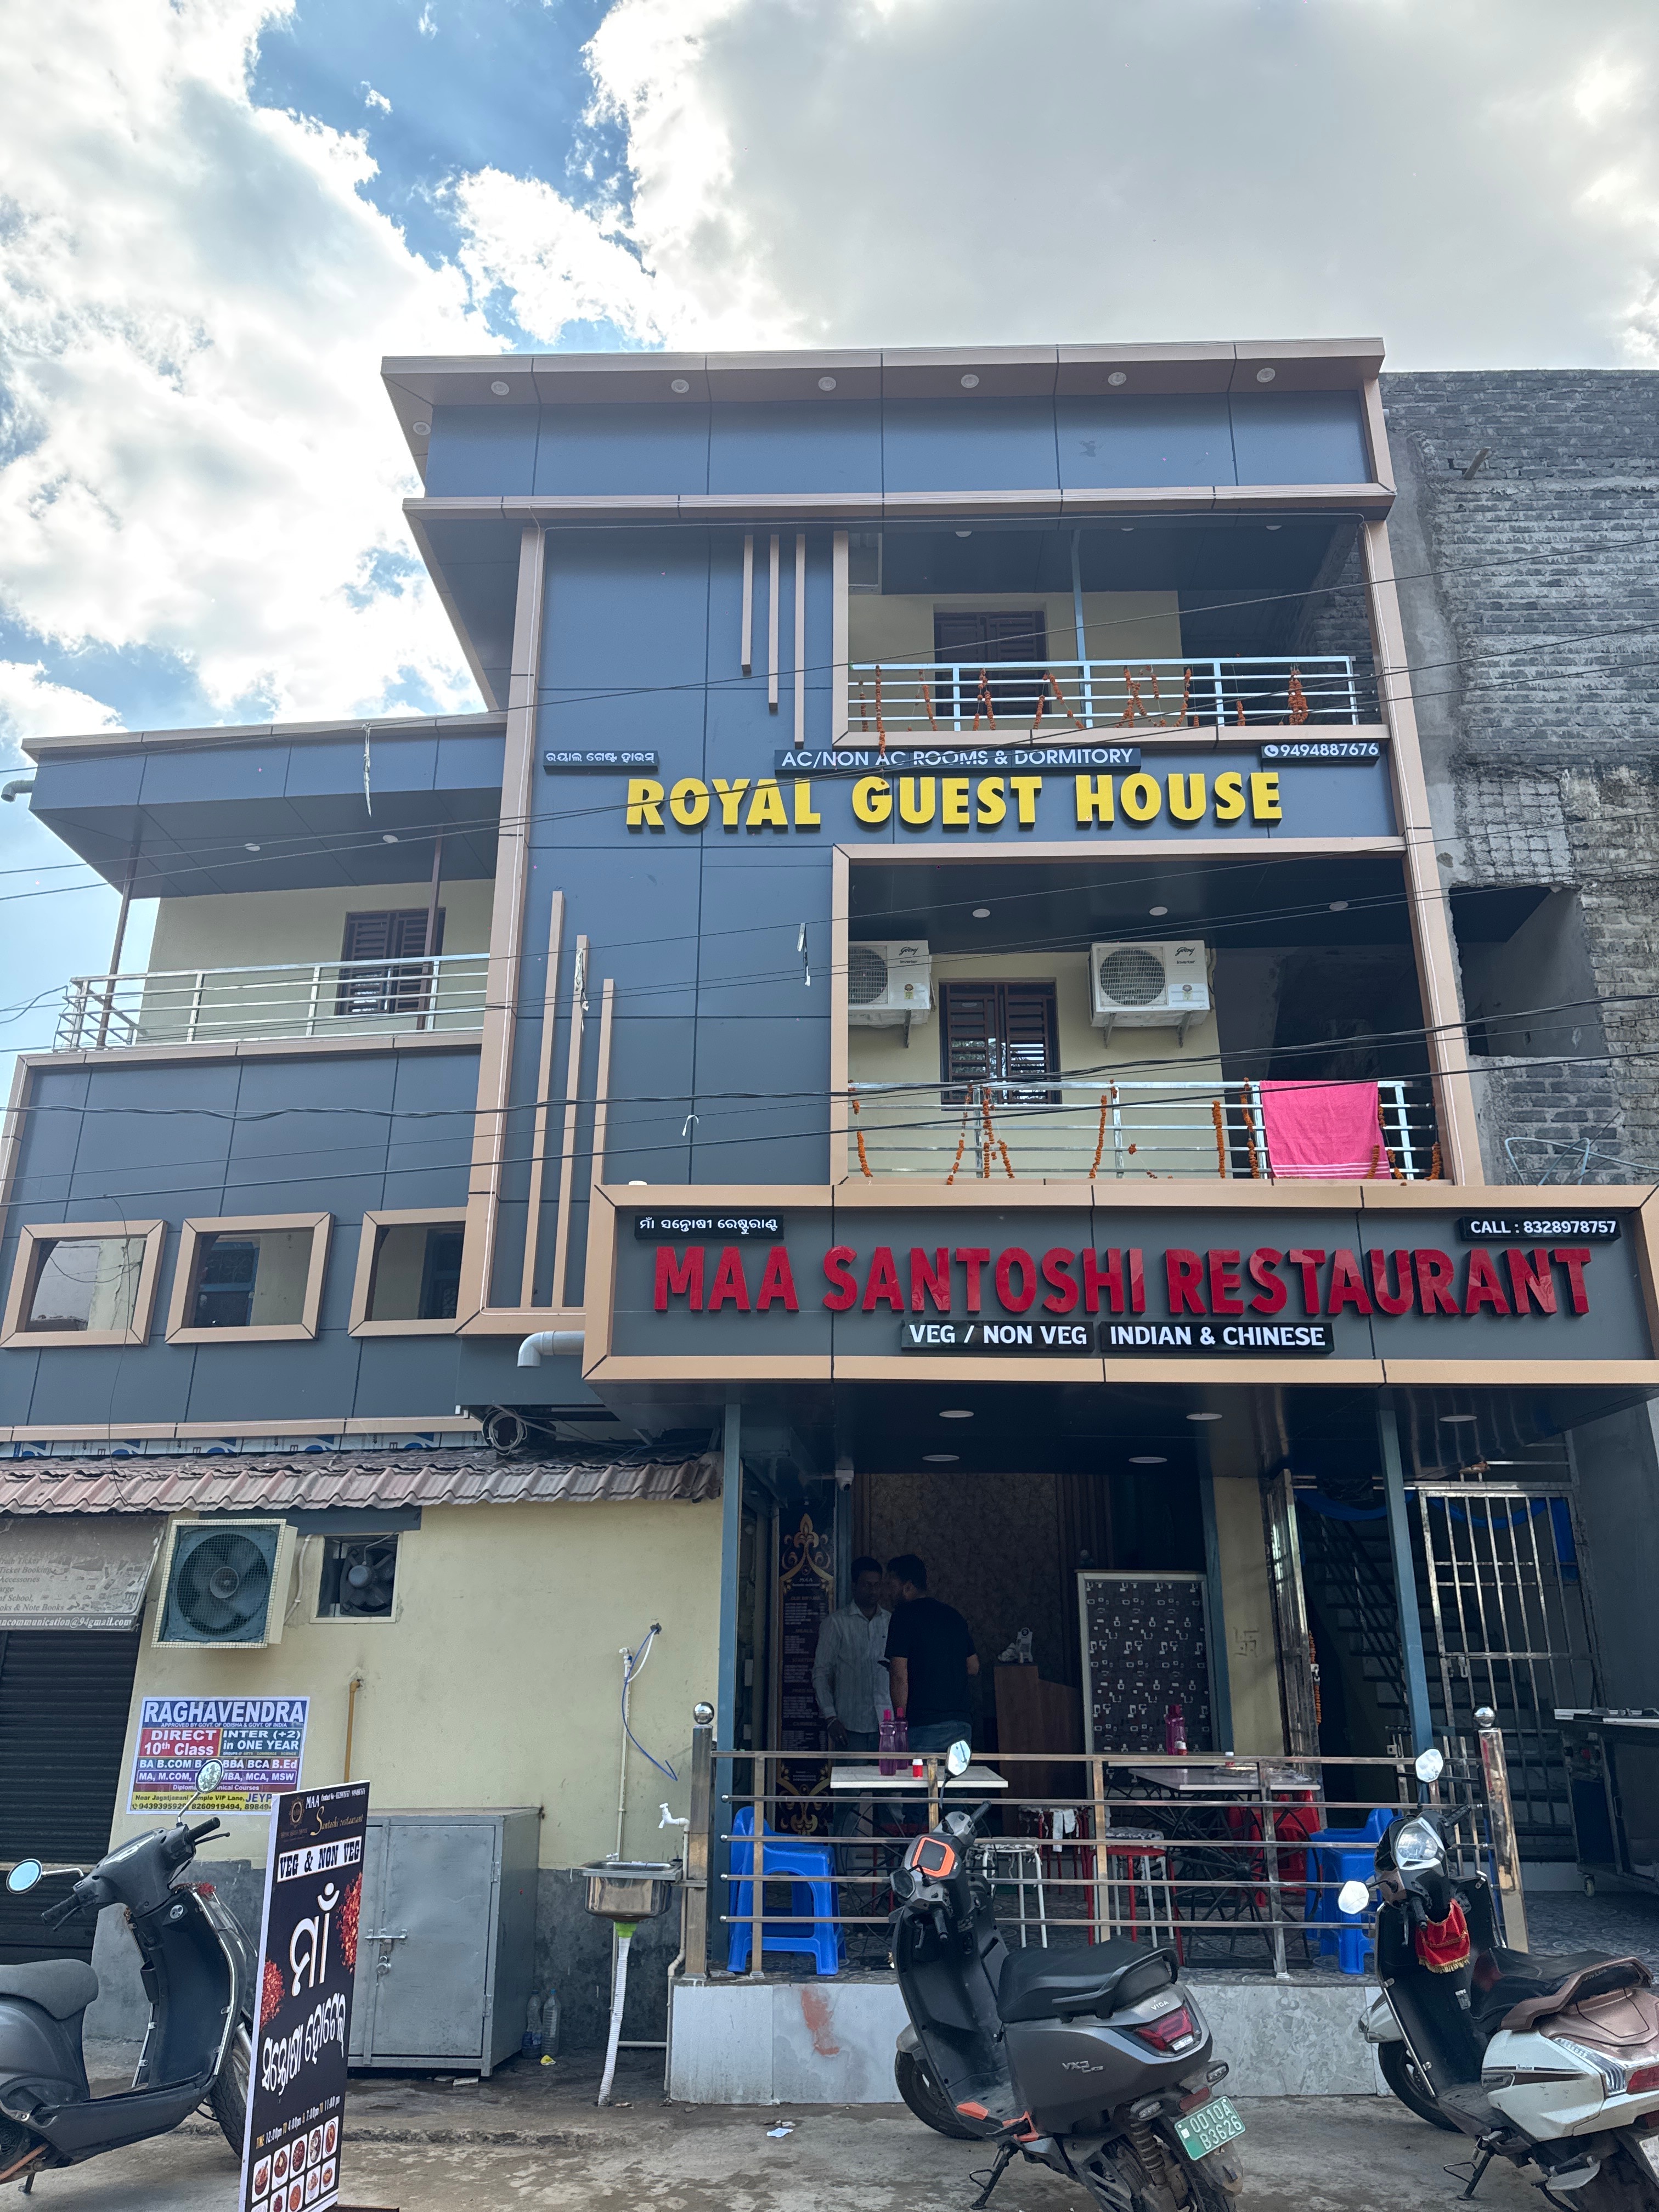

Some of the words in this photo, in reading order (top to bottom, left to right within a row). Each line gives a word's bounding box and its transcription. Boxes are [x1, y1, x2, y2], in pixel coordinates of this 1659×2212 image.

[1280, 743, 1379, 757] 9494887676
[546, 752, 582, 762] ରୟାଲ
[781, 751, 868, 769] AC/NON
[875, 751, 906, 766] AC
[913, 749, 988, 765] ROOMS
[994, 749, 1008, 765] &
[1015, 748, 1133, 764] DORMITORY
[627, 778, 820, 826] ROYAL
[853, 776, 1041, 825] GUEST
[1076, 772, 1282, 821] HOUSE
[1470, 1221, 1511, 1233] CALL
[1523, 1221, 1616, 1233] 8328978757
[654, 1246, 799, 1311] MAA
[822, 1246, 1146, 1313] SANTOSHI
[1165, 1247, 1592, 1314] RESTAURANT
[909, 1324, 956, 1344] VEG
[963, 1325, 975, 1344] /
[983, 1325, 1032, 1345] NON
[1040, 1326, 1087, 1345] VEG
[1110, 1326, 1192, 1345] INDIAN
[1200, 1327, 1216, 1345] &
[1223, 1327, 1325, 1346] CHINESE
[0, 1617, 132, 1628] ncommunication@94gmail.com
[144, 1701, 304, 1723] RAGHAVENDRA
[151, 1730, 217, 1740] DIRECT
[223, 1730, 268, 1738] INTER
[273, 1730, 301, 1740] (+2)
[144, 1742, 170, 1756] 10th
[174, 1743, 214, 1756] Class
[223, 1740, 234, 1750] in
[237, 1740, 262, 1750] ONE
[267, 1740, 299, 1750] YEAR
[139, 1759, 154, 1768] BA
[157, 1759, 191, 1768] B.COM
[223, 1759, 244, 1768] BBA
[247, 1759, 269, 1768] BCA
[272, 1759, 297, 1769] B.Ed
[139, 1773, 155, 1781] MA,
[158, 1773, 191, 1781] M.COM,
[246, 1773, 269, 1781] MCA,
[246, 1793, 272, 1802] JEYP
[306, 1795, 319, 1809] MAA
[280, 1853, 299, 1878] VEG
[304, 1850, 313, 1873] &
[318, 1844, 338, 1870] NON
[344, 1840, 360, 1863] VEG
[1150, 2000, 1169, 2010] VIDA
[1199, 2115, 1242, 2150] B3626
